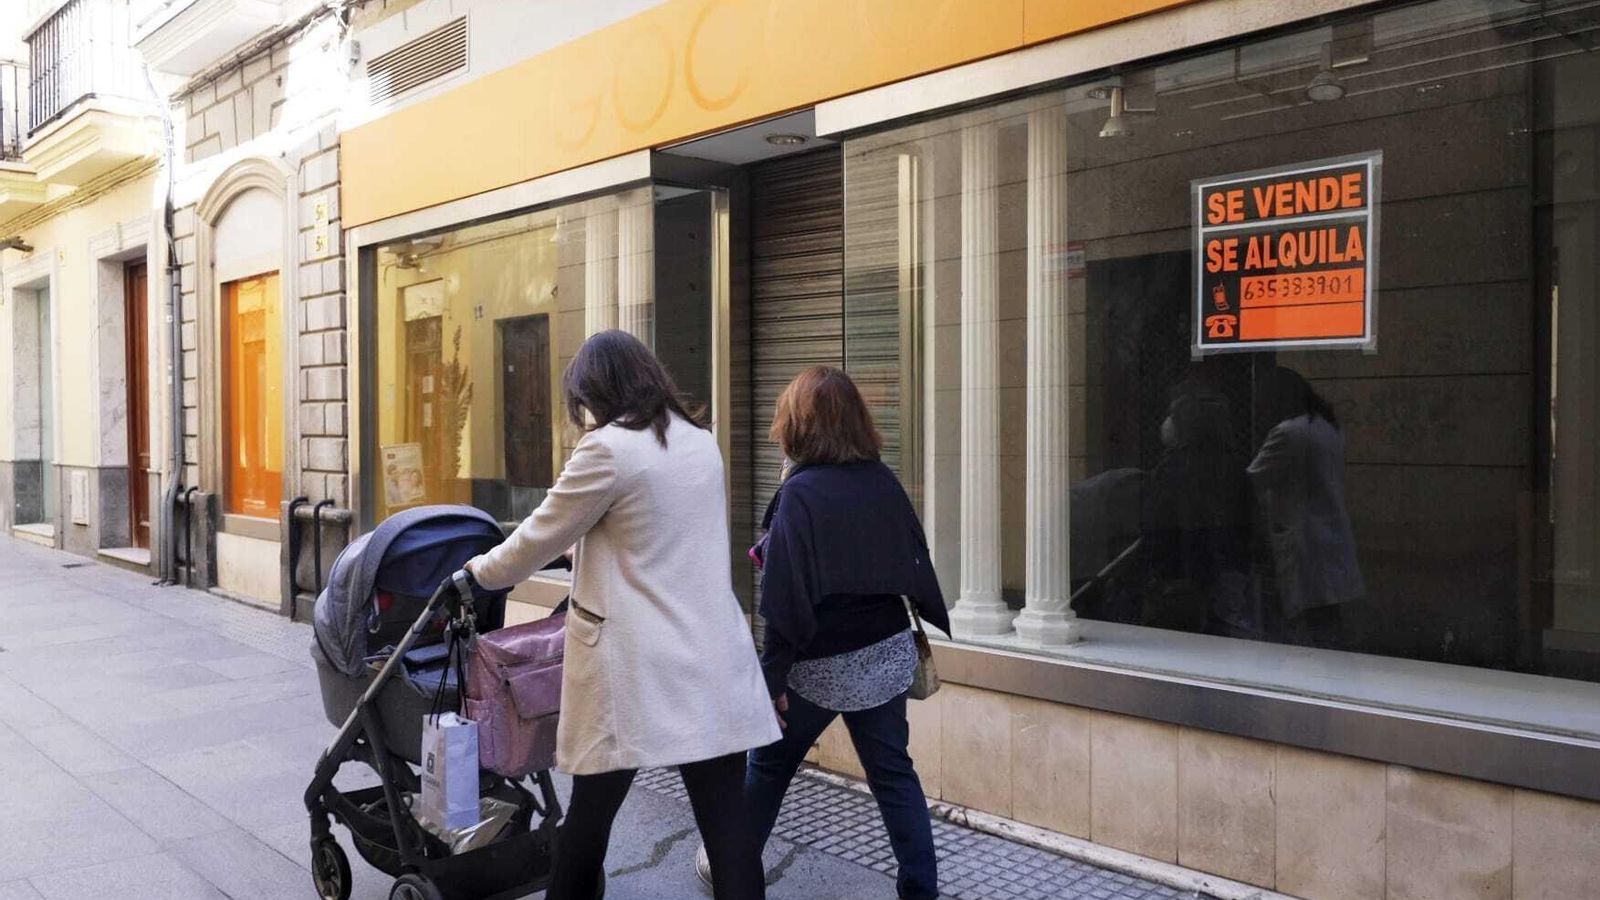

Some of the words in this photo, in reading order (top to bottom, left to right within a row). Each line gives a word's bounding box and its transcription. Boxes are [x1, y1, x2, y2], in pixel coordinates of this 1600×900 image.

[1207, 189, 1245, 225] SE
[1253, 172, 1362, 219] VENDE
[1206, 238, 1239, 273] SE
[1244, 225, 1364, 269] ALQUILA
